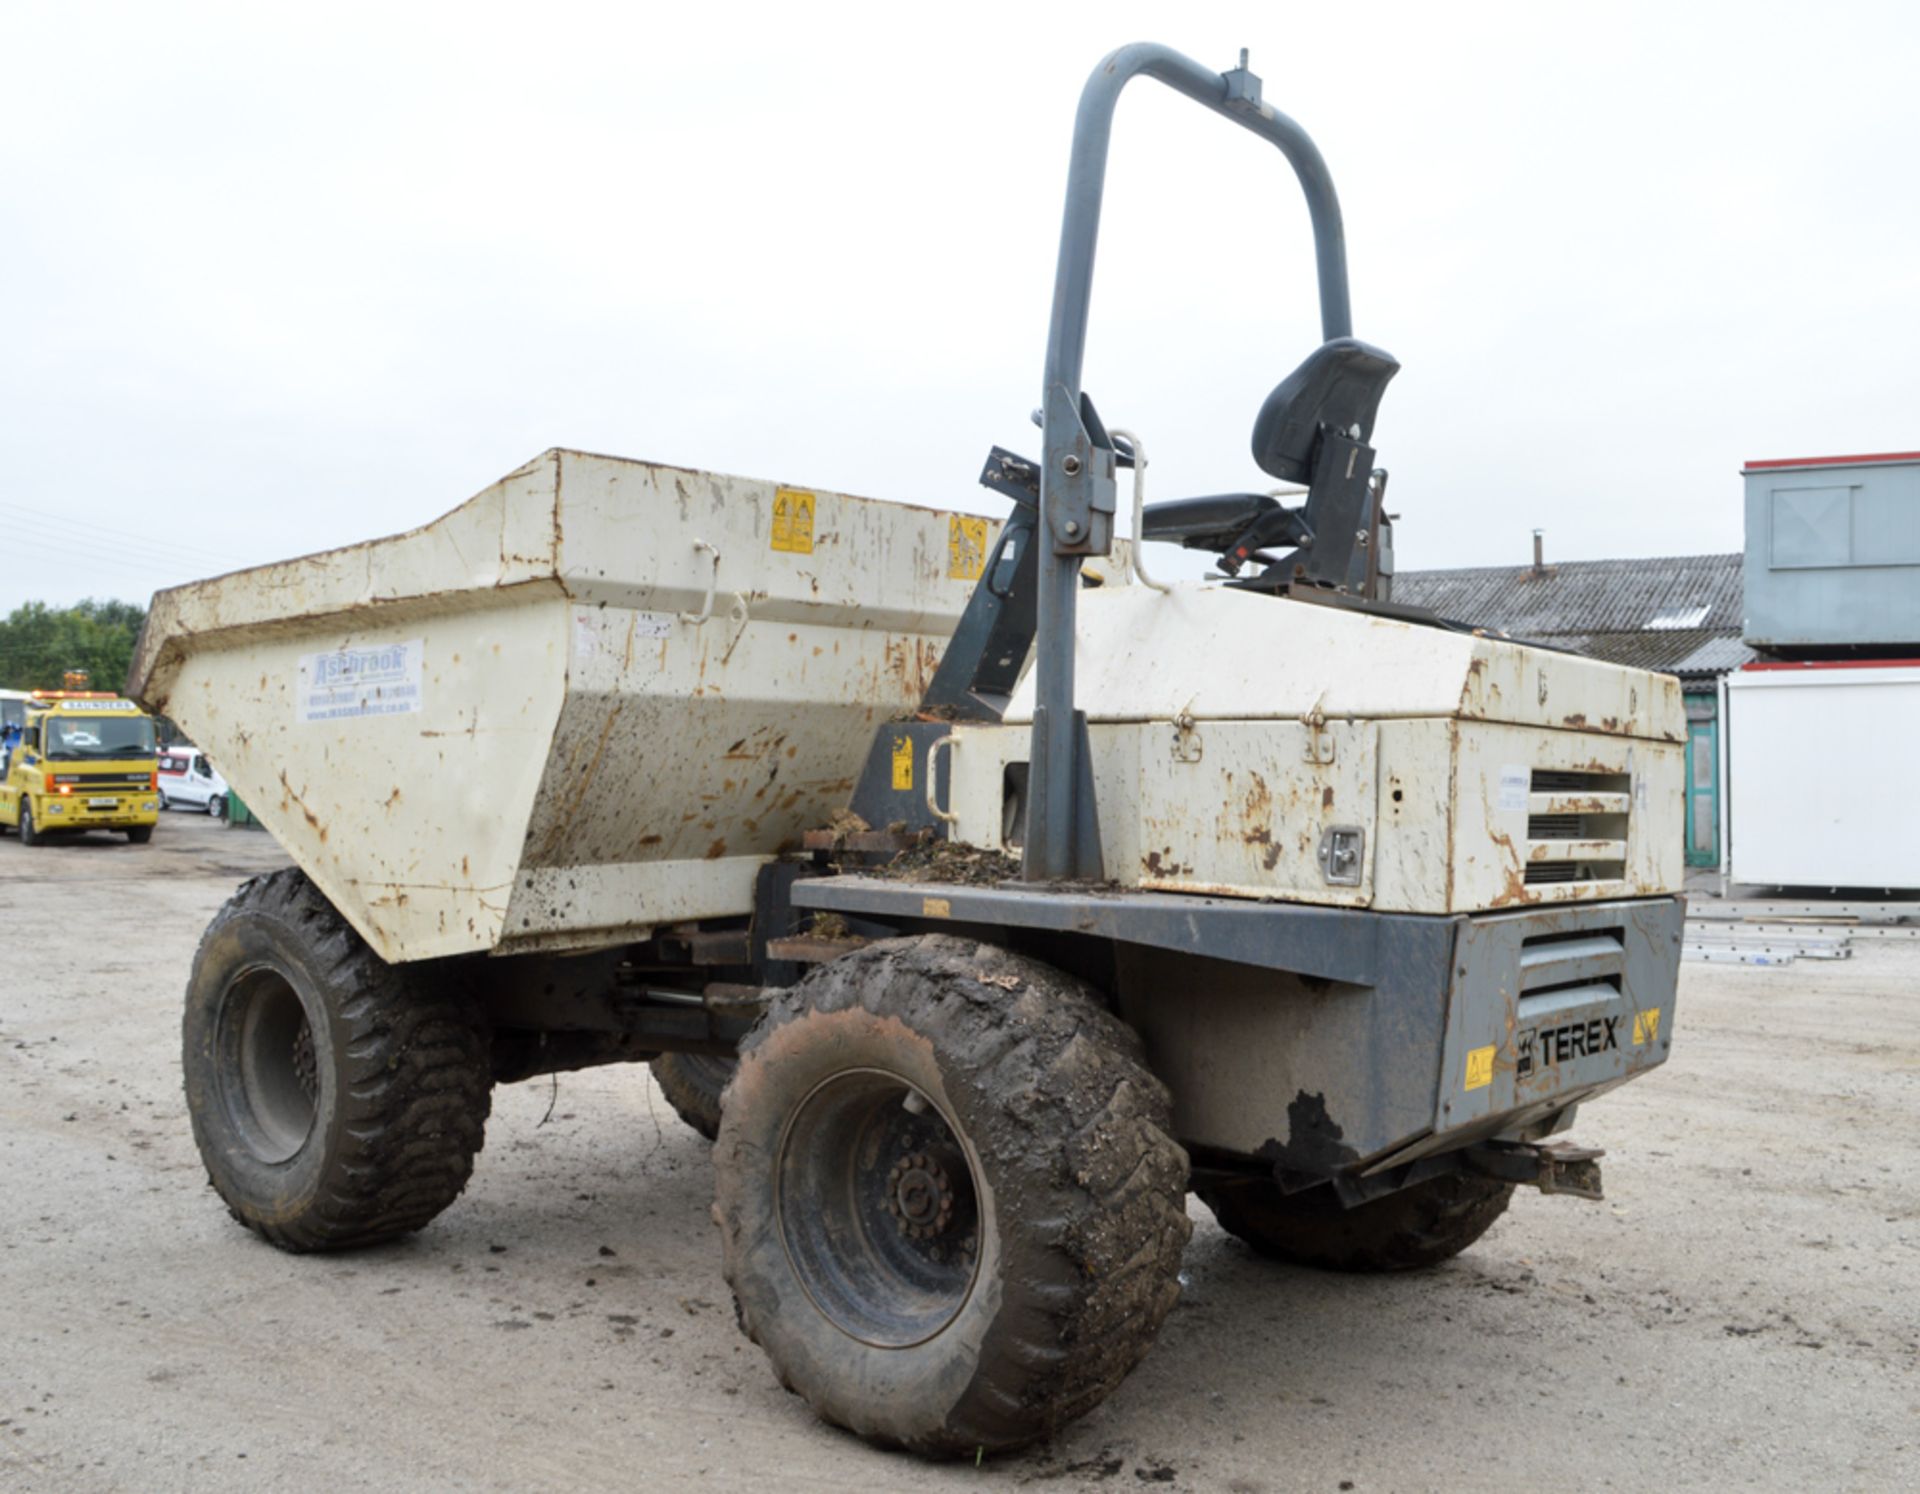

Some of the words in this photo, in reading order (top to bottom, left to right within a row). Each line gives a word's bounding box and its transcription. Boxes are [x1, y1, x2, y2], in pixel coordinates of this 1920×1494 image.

[314, 647, 403, 685] Ashbrook
[69, 701, 132, 710] SAUNDERS
[1539, 1015, 1618, 1065] TEREX
